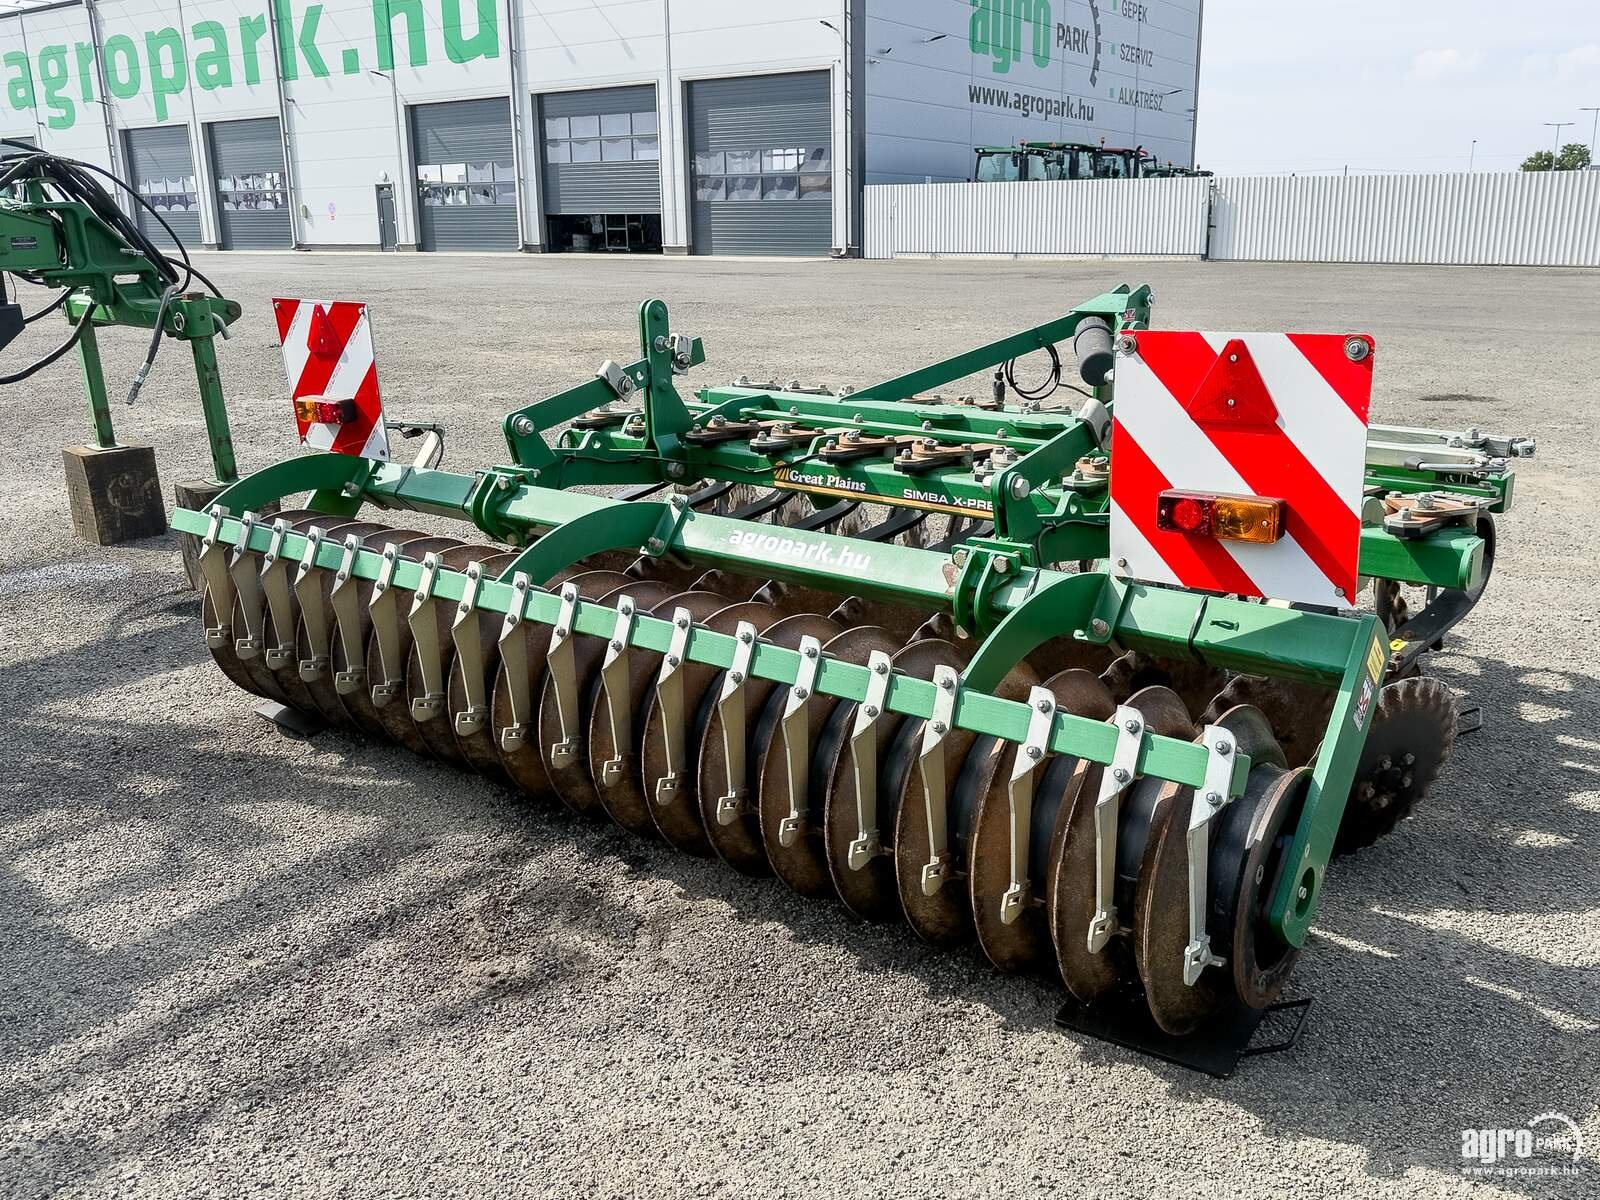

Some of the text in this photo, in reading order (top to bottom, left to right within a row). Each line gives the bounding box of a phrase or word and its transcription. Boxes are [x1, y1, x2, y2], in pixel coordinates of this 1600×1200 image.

[969, 0, 1090, 74] agro PARK
[3, 0, 500, 130] agropark.hu
[1119, 43, 1154, 68] SZERVIZ
[968, 84, 1095, 122] www.agropark.hu
[1118, 88, 1164, 112] ALKATRÉSZ
[789, 469, 866, 492] Great Plains
[903, 488, 949, 504] SIMBA
[729, 527, 872, 571] agropark.hu
